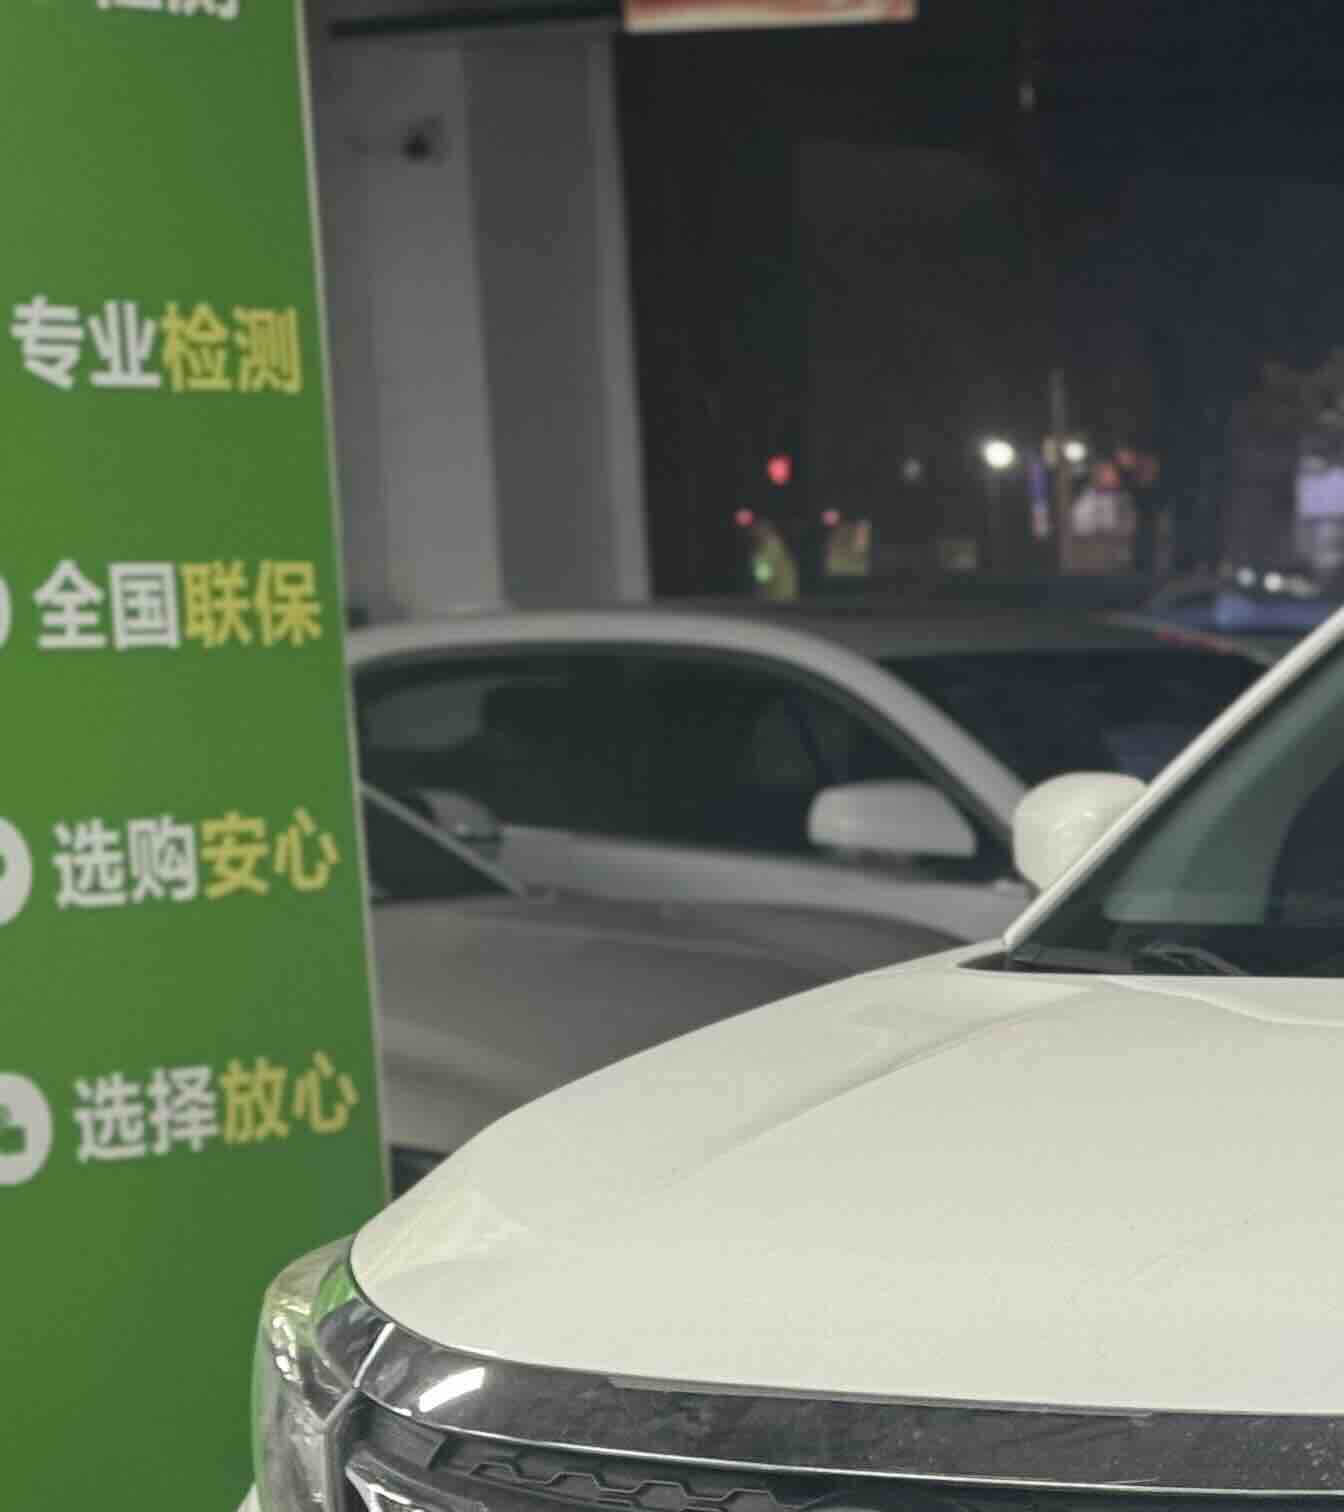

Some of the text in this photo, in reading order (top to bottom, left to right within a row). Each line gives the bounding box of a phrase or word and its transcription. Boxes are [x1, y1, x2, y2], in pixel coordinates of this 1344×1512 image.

[11, 295, 303, 396] 专业检测
[33, 558, 322, 652] 全国联保
[51, 806, 341, 910] 选购安心
[73, 1051, 360, 1164] 选择放心
